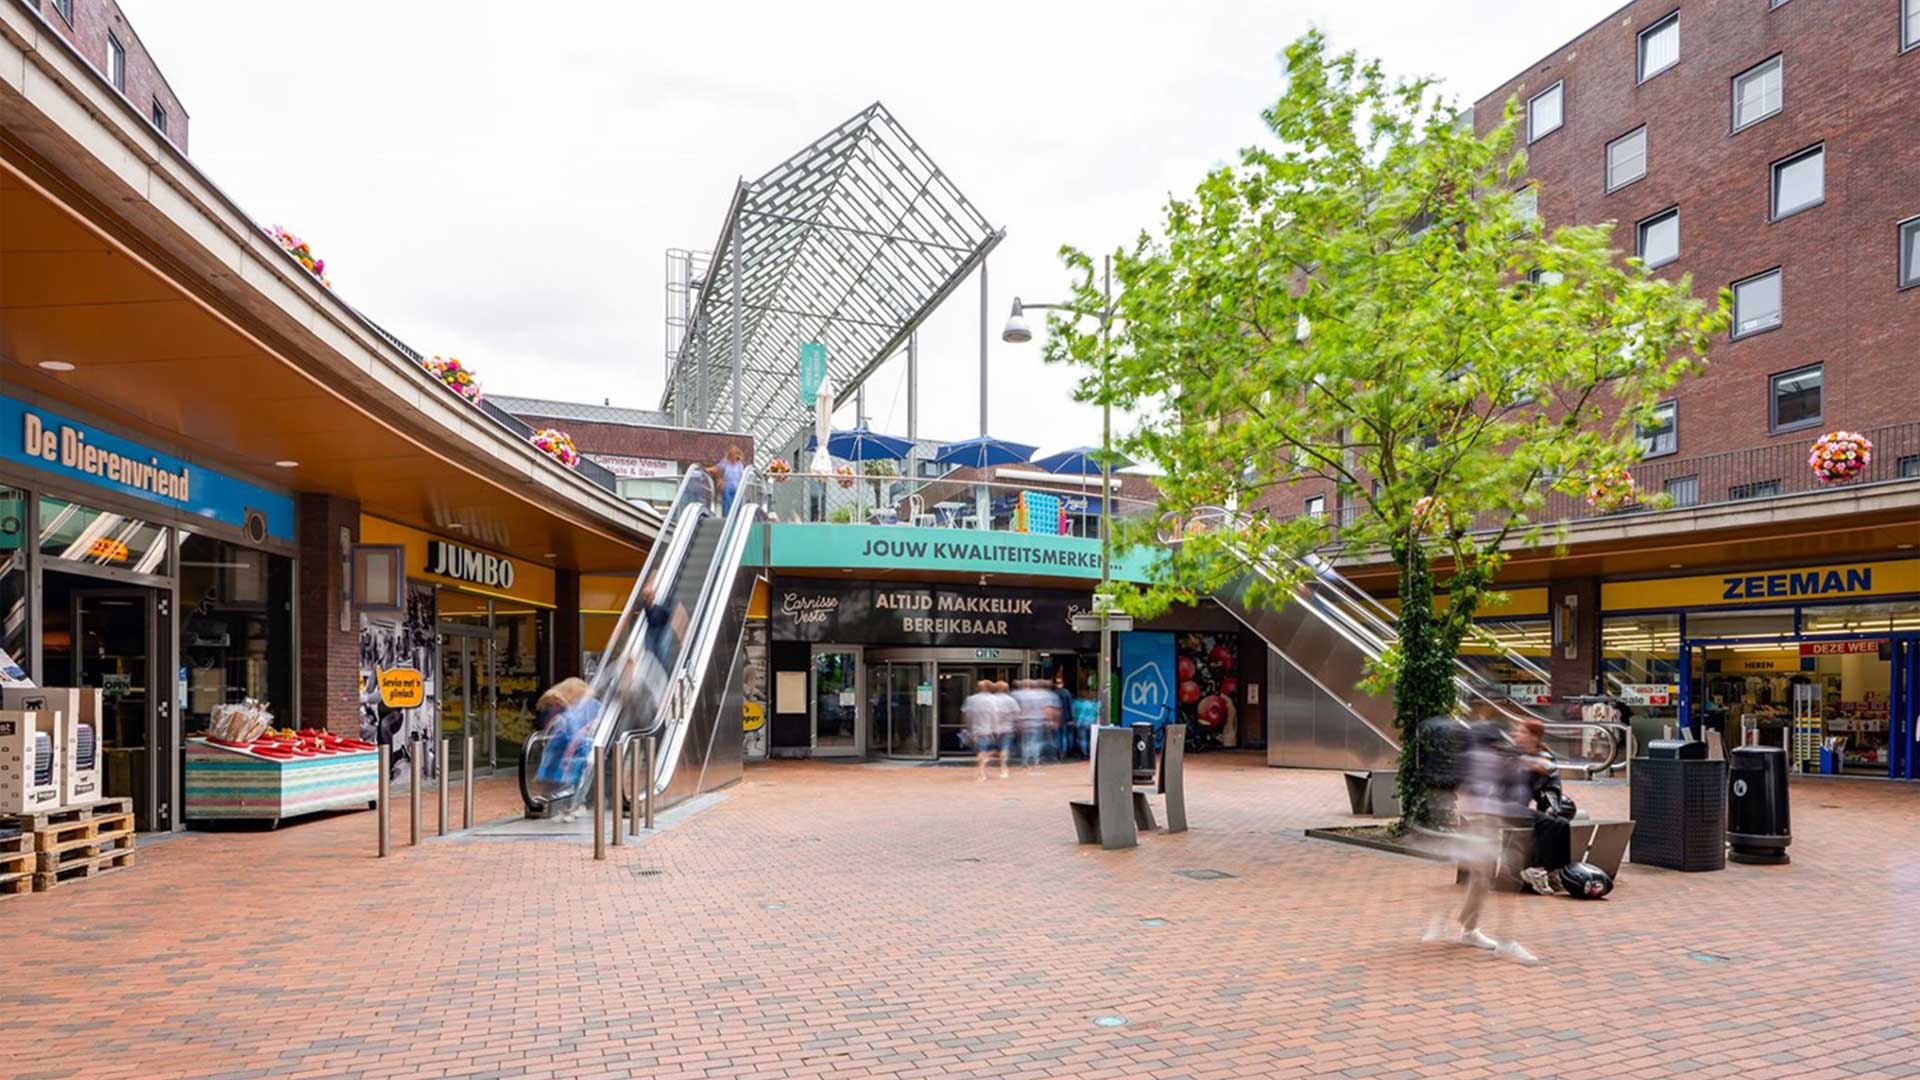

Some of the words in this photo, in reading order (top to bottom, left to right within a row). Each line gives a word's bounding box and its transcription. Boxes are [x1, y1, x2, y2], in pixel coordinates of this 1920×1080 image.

[24, 413, 57, 461] De
[61, 425, 190, 502] Dierenvriend
[593, 455, 637, 466] Carnisse
[640, 458, 667, 469] Veste
[862, 540, 928, 558] JOUW
[434, 541, 514, 590] JUMBO
[1723, 568, 1872, 600] ZEEMAN
[783, 593, 839, 613] Carnisse
[875, 593, 932, 610] ALTIJD
[937, 597, 1033, 614] MAKKELIJK
[903, 617, 1008, 635] BEREIKBAAR
[1813, 643, 1846, 654] DEZE
[1849, 641, 1880, 653] WEE
[1744, 660, 1775, 669] HEREN
[103, 681, 129, 690] OPEN
